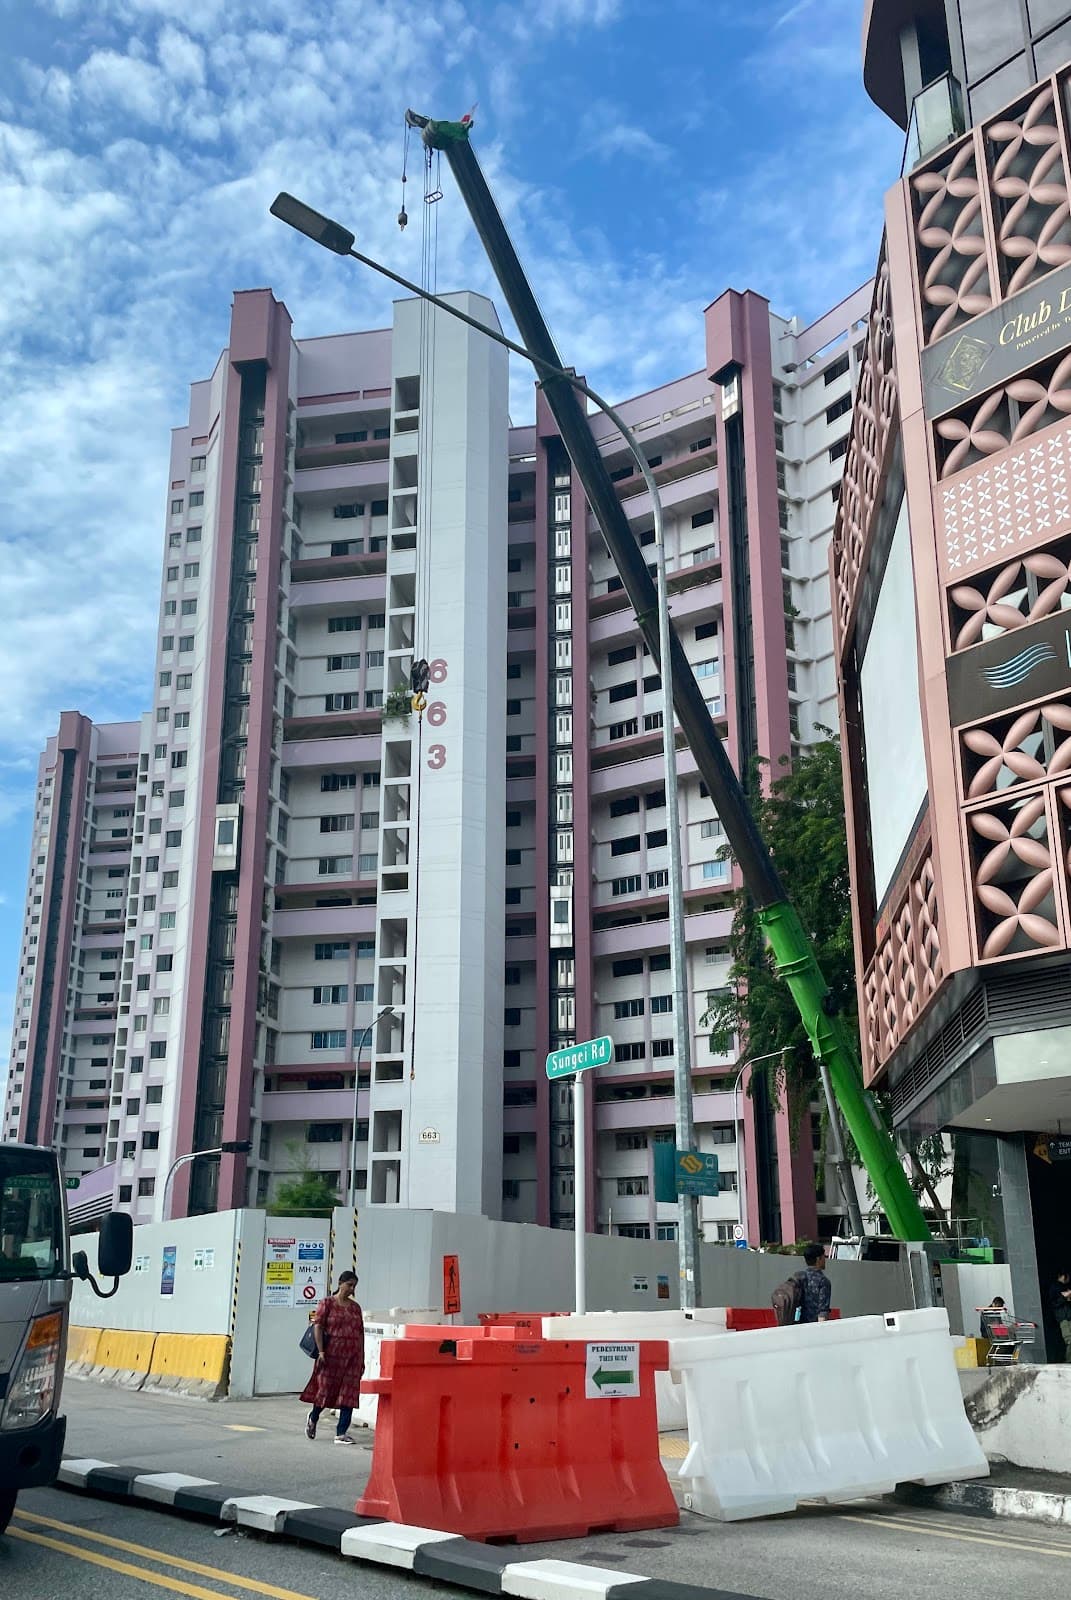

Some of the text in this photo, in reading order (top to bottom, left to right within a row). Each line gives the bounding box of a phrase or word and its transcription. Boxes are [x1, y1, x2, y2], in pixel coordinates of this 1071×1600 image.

[999, 300, 1051, 345] Club
[552, 1040, 605, 1071] Sungei Rd
[422, 1131, 437, 1139] 663
